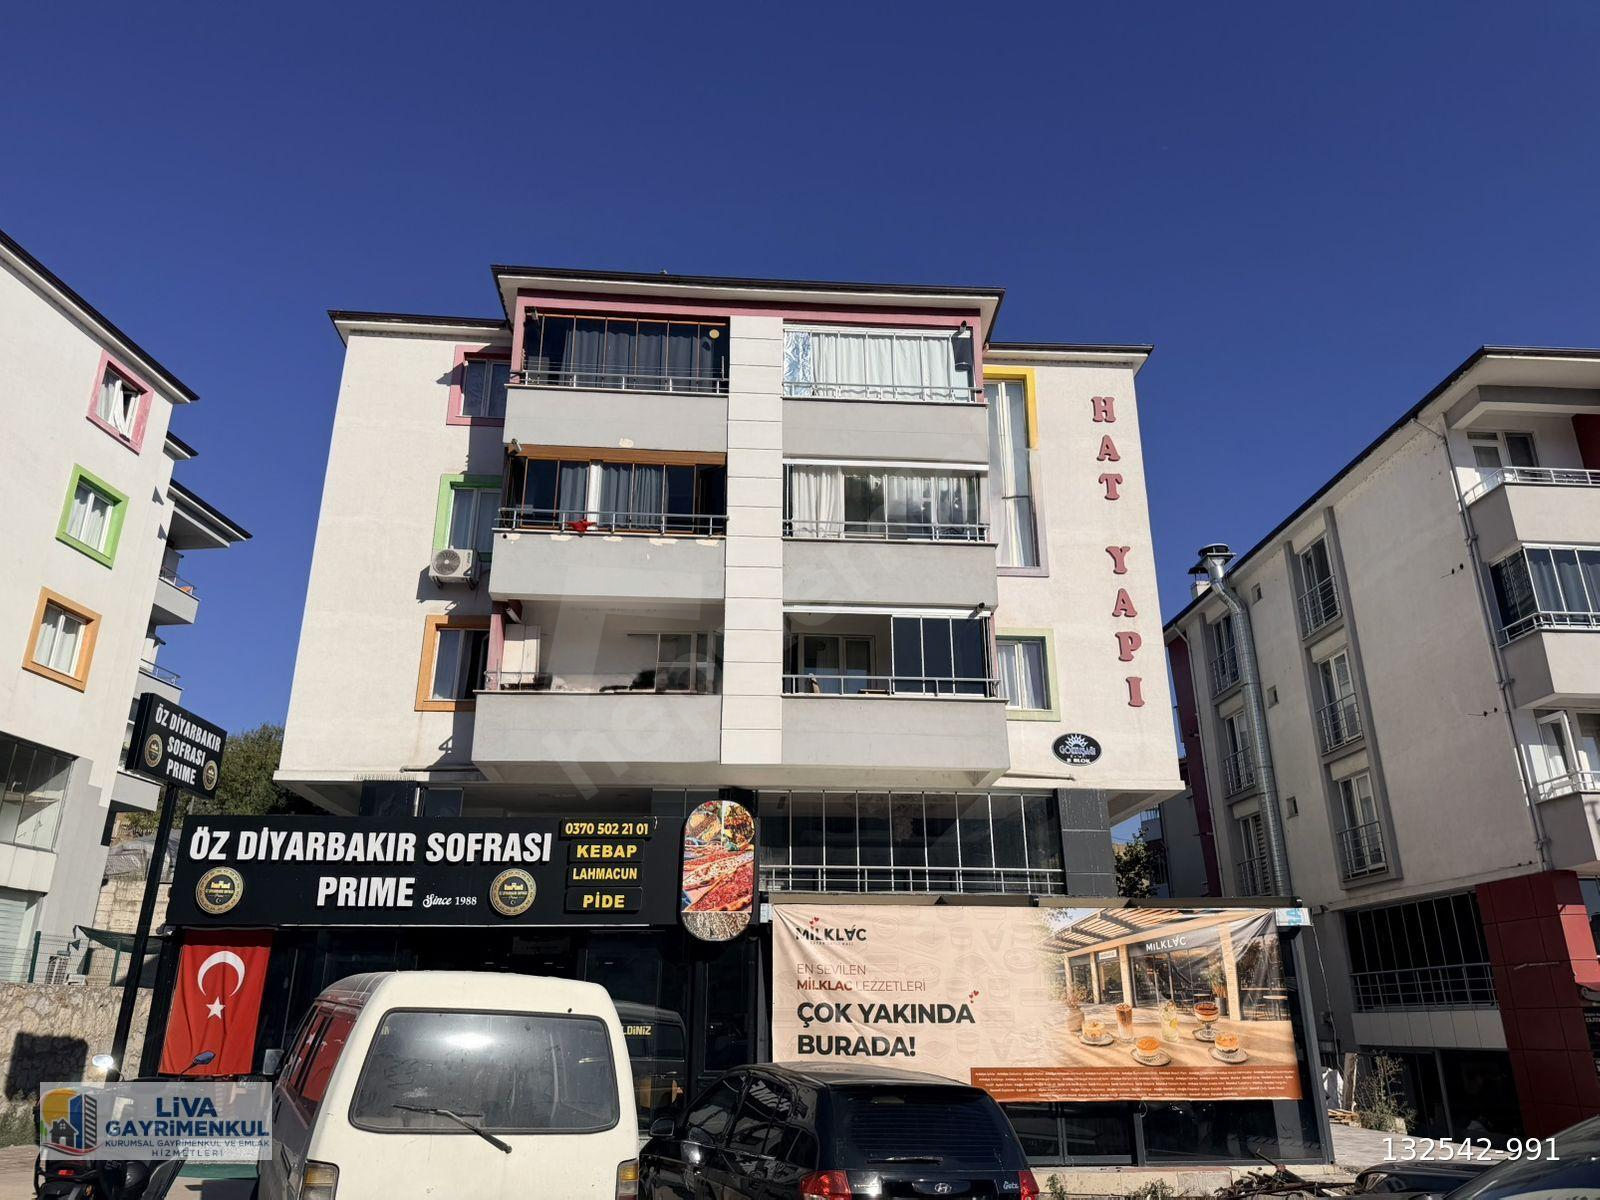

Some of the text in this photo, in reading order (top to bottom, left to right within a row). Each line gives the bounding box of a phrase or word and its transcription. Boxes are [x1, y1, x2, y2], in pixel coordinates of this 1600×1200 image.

[1091, 396, 1145, 707] HAT YAPI
[155, 703, 222, 752] ÖZ DİYARBAKIR
[167, 736, 206, 767] SOFRASI
[166, 758, 196, 785] PRIME
[565, 822, 649, 835] 0370 502 21 01
[189, 826, 552, 863] ÖZ DİYARBAKIR SOFRASI
[576, 844, 638, 859] KEBAP
[572, 867, 638, 881] LAHMACUN
[316, 876, 477, 908] PRIME Since 1988
[582, 892, 625, 909] PİDE
[796, 962, 866, 975] EN SEVİLEN
[855, 979, 926, 992] LEZZETLERİ
[797, 1002, 975, 1028] ÇOK YAKINDA
[797, 1034, 916, 1057] BURADA!
